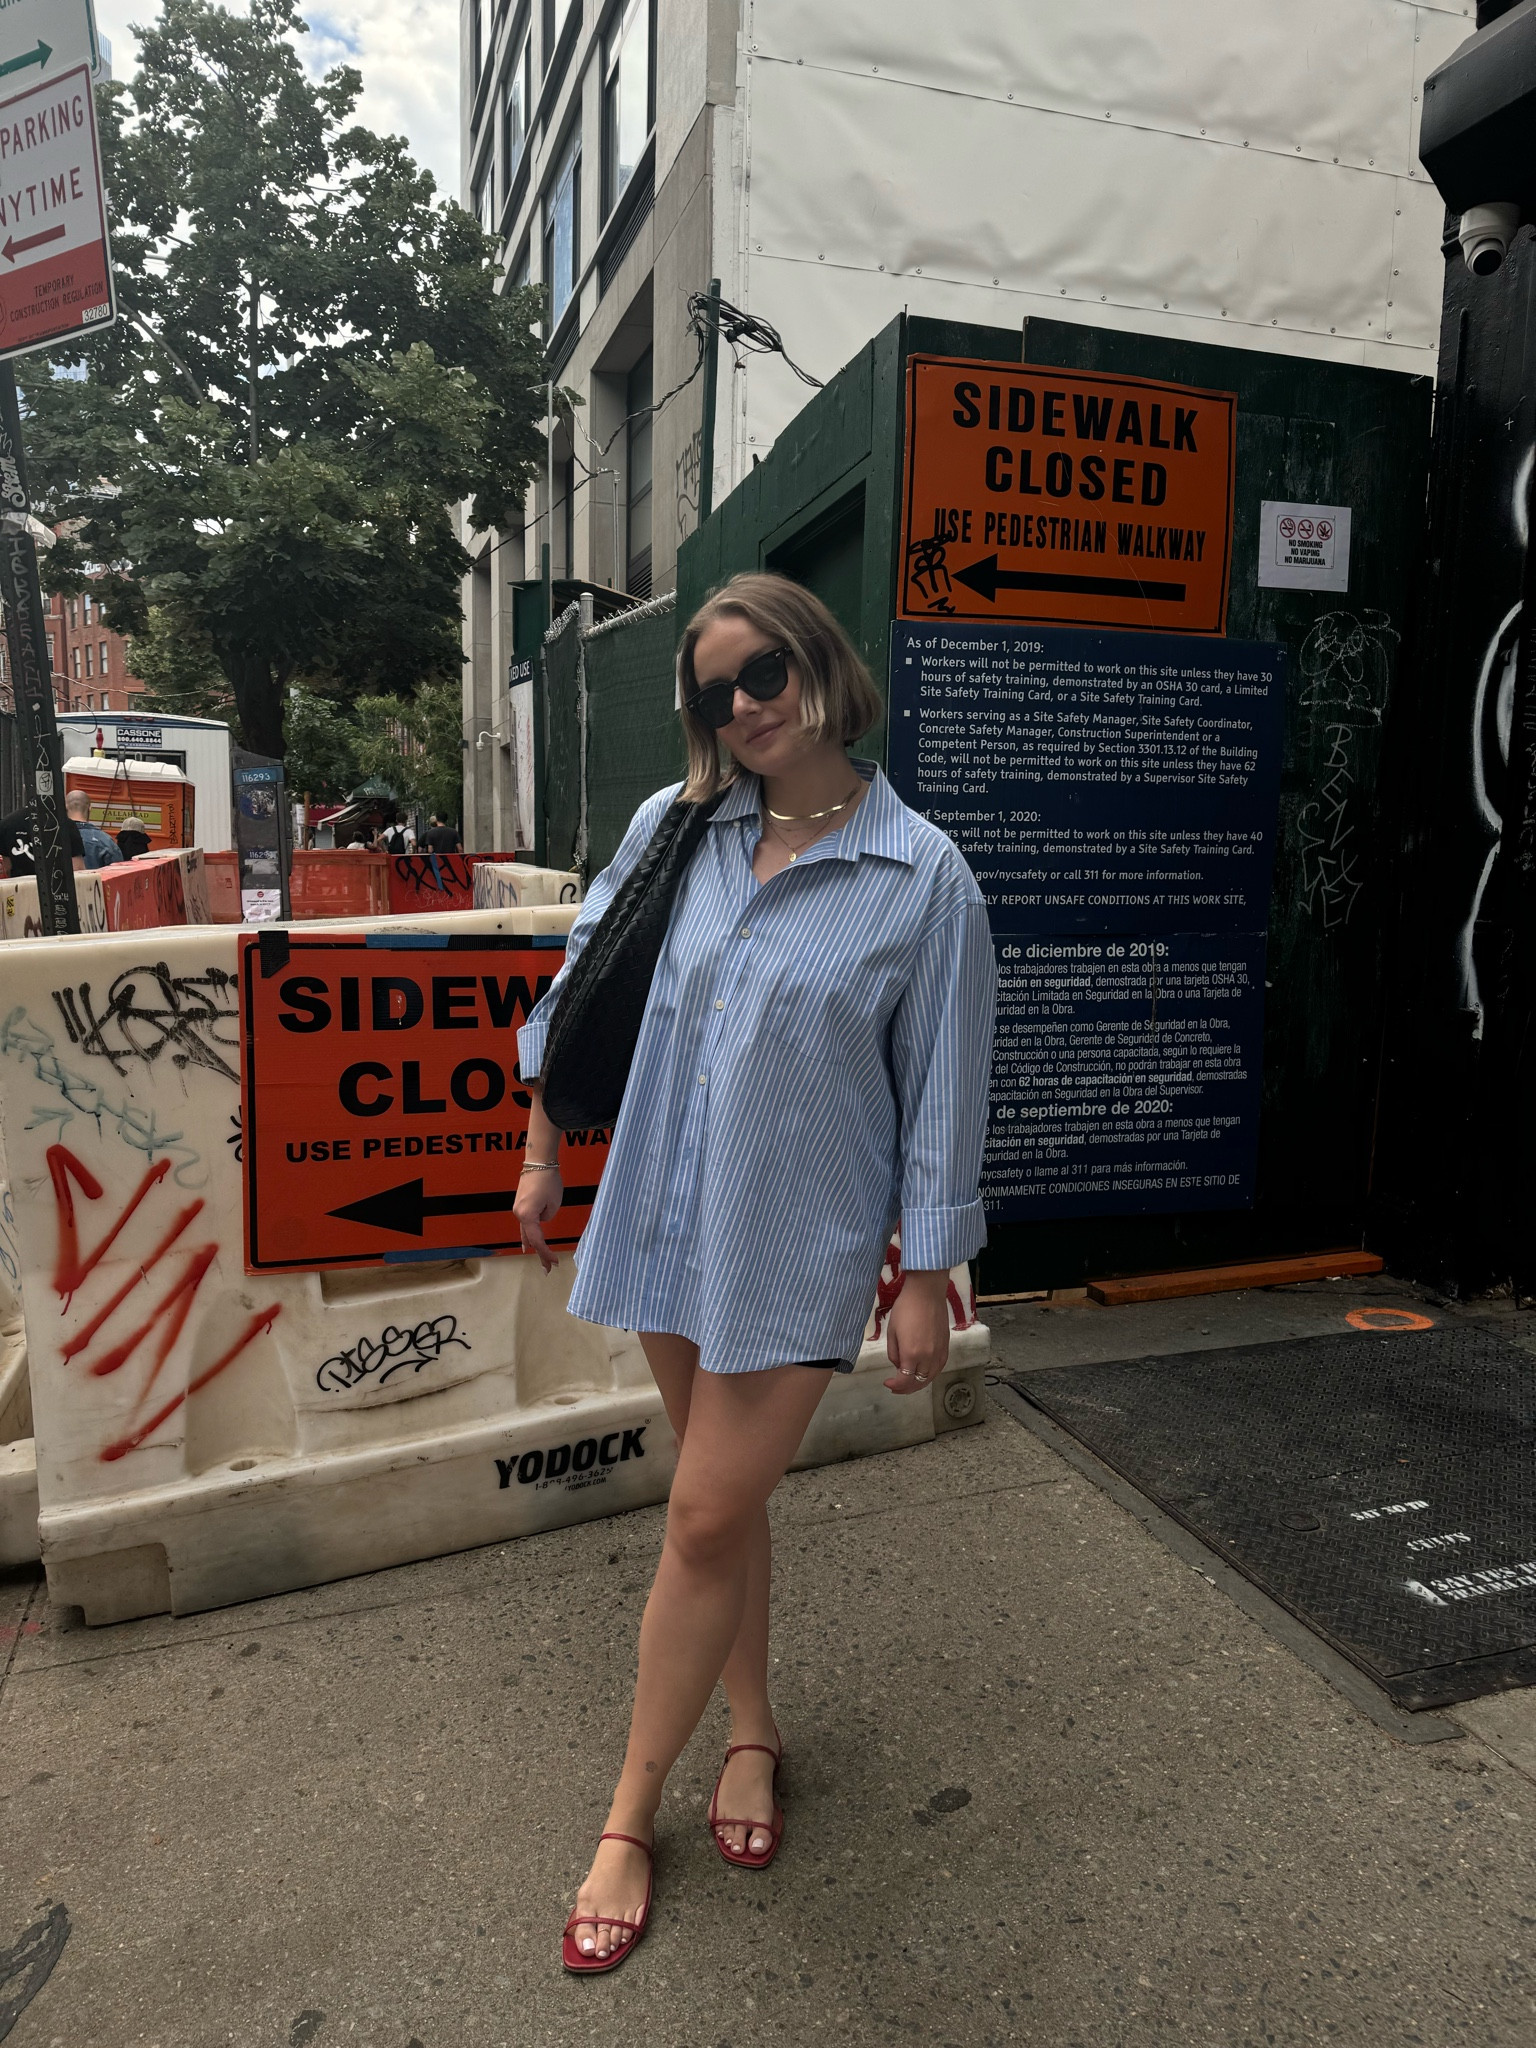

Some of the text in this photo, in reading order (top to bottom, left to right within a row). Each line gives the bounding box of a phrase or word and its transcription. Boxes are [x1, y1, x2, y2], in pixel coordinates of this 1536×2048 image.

[0, 95, 84, 159] PARKING
[0, 166, 84, 227] NYTIME
[34, 275, 74, 298] TEMPORARY
[10, 281, 104, 322] CONSTRUCTION REGULATION
[84, 304, 108, 321] 32780
[952, 382, 1198, 452] SIDEWALK
[985, 446, 1167, 506] CLOSED
[934, 508, 1206, 562] USE PEDESTRIAN WALKWAY
[1298, 540, 1323, 548] SMOKING
[1294, 557, 1325, 565] MARIJUANA
[907, 637, 1044, 653] As of December 1, 2019:
[520, 660, 530, 678] USE
[922, 656, 966, 667] Workers
[969, 657, 988, 668] will
[992, 659, 1010, 669] not
[1013, 659, 1025, 670] be
[1029, 661, 1080, 672] permitted
[1084, 662, 1094, 672] to
[1097, 664, 1121, 674] work
[1139, 665, 1157, 675] this
[1160, 666, 1178, 676] site
[1181, 668, 1211, 678] unless
[1214, 669, 1234, 682] they
[1237, 670, 1258, 681] have
[1261, 672, 1272, 682] 30
[921, 670, 951, 682] hours
[955, 672, 966, 682] of
[969, 673, 1002, 686] safety
[1005, 674, 1048, 688] training,
[1053, 676, 1123, 688] demonstrated
[1127, 679, 1138, 691] by
[1156, 681, 1183, 691] OSHA
[1186, 682, 1198, 692] 30
[1201, 683, 1222, 695] card,
[1235, 684, 1268, 696] Limited
[920, 686, 942, 697] Site
[945, 687, 980, 700] Safety
[983, 688, 1024, 702] Training
[1028, 690, 1053, 702] Card,
[1080, 691, 1100, 702] Site
[1104, 692, 1135, 706] Safety
[1138, 694, 1176, 708] Training
[1179, 696, 1202, 706] Card.
[920, 708, 963, 719] Workers
[967, 710, 1006, 723] serving
[1009, 713, 1020, 721] as
[1034, 711, 1054, 722] Site
[1057, 712, 1090, 725] Safety
[1093, 714, 1138, 727] Manager,
[1142, 716, 1161, 726] Site
[1164, 716, 1194, 729] Safety
[1198, 718, 1252, 731] Coordinator,
[117, 729, 160, 737] CASSONE
[919, 723, 965, 734] Concrete
[969, 724, 1003, 738] Safety
[1007, 726, 1054, 739] Manager,
[1058, 727, 1121, 738] Construction
[1125, 729, 1200, 741] Superintendent
[102, 810, 149, 818] CALLAHEAD
[934, 810, 995, 823] September
[998, 811, 1006, 823] 1,
[1010, 811, 1041, 822] 2020:
[976, 870, 1047, 882] gov/nycsafety
[1064, 870, 1082, 879] call
[1084, 870, 1098, 879] 311
[1102, 870, 1116, 879] for
[1146, 870, 1204, 880] information.
[1002, 895, 1042, 904] REPORT
[1045, 895, 1085, 905] UNSAFE
[1088, 895, 1150, 904] CONDITIONS
[1153, 895, 1165, 904] AT
[1168, 895, 1190, 904] THIS
[1193, 895, 1221, 904] WORK
[1224, 895, 1246, 906] SITE,
[1002, 942, 1169, 958] de diciembre de 2019:
[1014, 963, 1068, 976] trabajadores
[1070, 963, 1106, 975] trabajen
[1108, 965, 1118, 973] en
[1122, 963, 1140, 972] esta
[1164, 964, 1169, 972] a
[1172, 963, 1200, 972] menos
[1202, 963, 1216, 973] que
[1219, 961, 1246, 973] tengan
[278, 974, 552, 1034] SIDEW
[997, 1100, 1173, 1120] de septiembre de 2020:
[286, 1130, 528, 1163] USE PEDESTRIA
[981, 1160, 1188, 1181] nycsafety o llame al 311 para más información.
[977, 1174, 1240, 1198] NÓNIMAMENTE CONDICIONES INSEGURAS EN ESTE SITIO DE
[494, 1426, 646, 1490] YODOCK
[1430, 1575, 1473, 1591] SAY
[1472, 1567, 1517, 1582] YES
